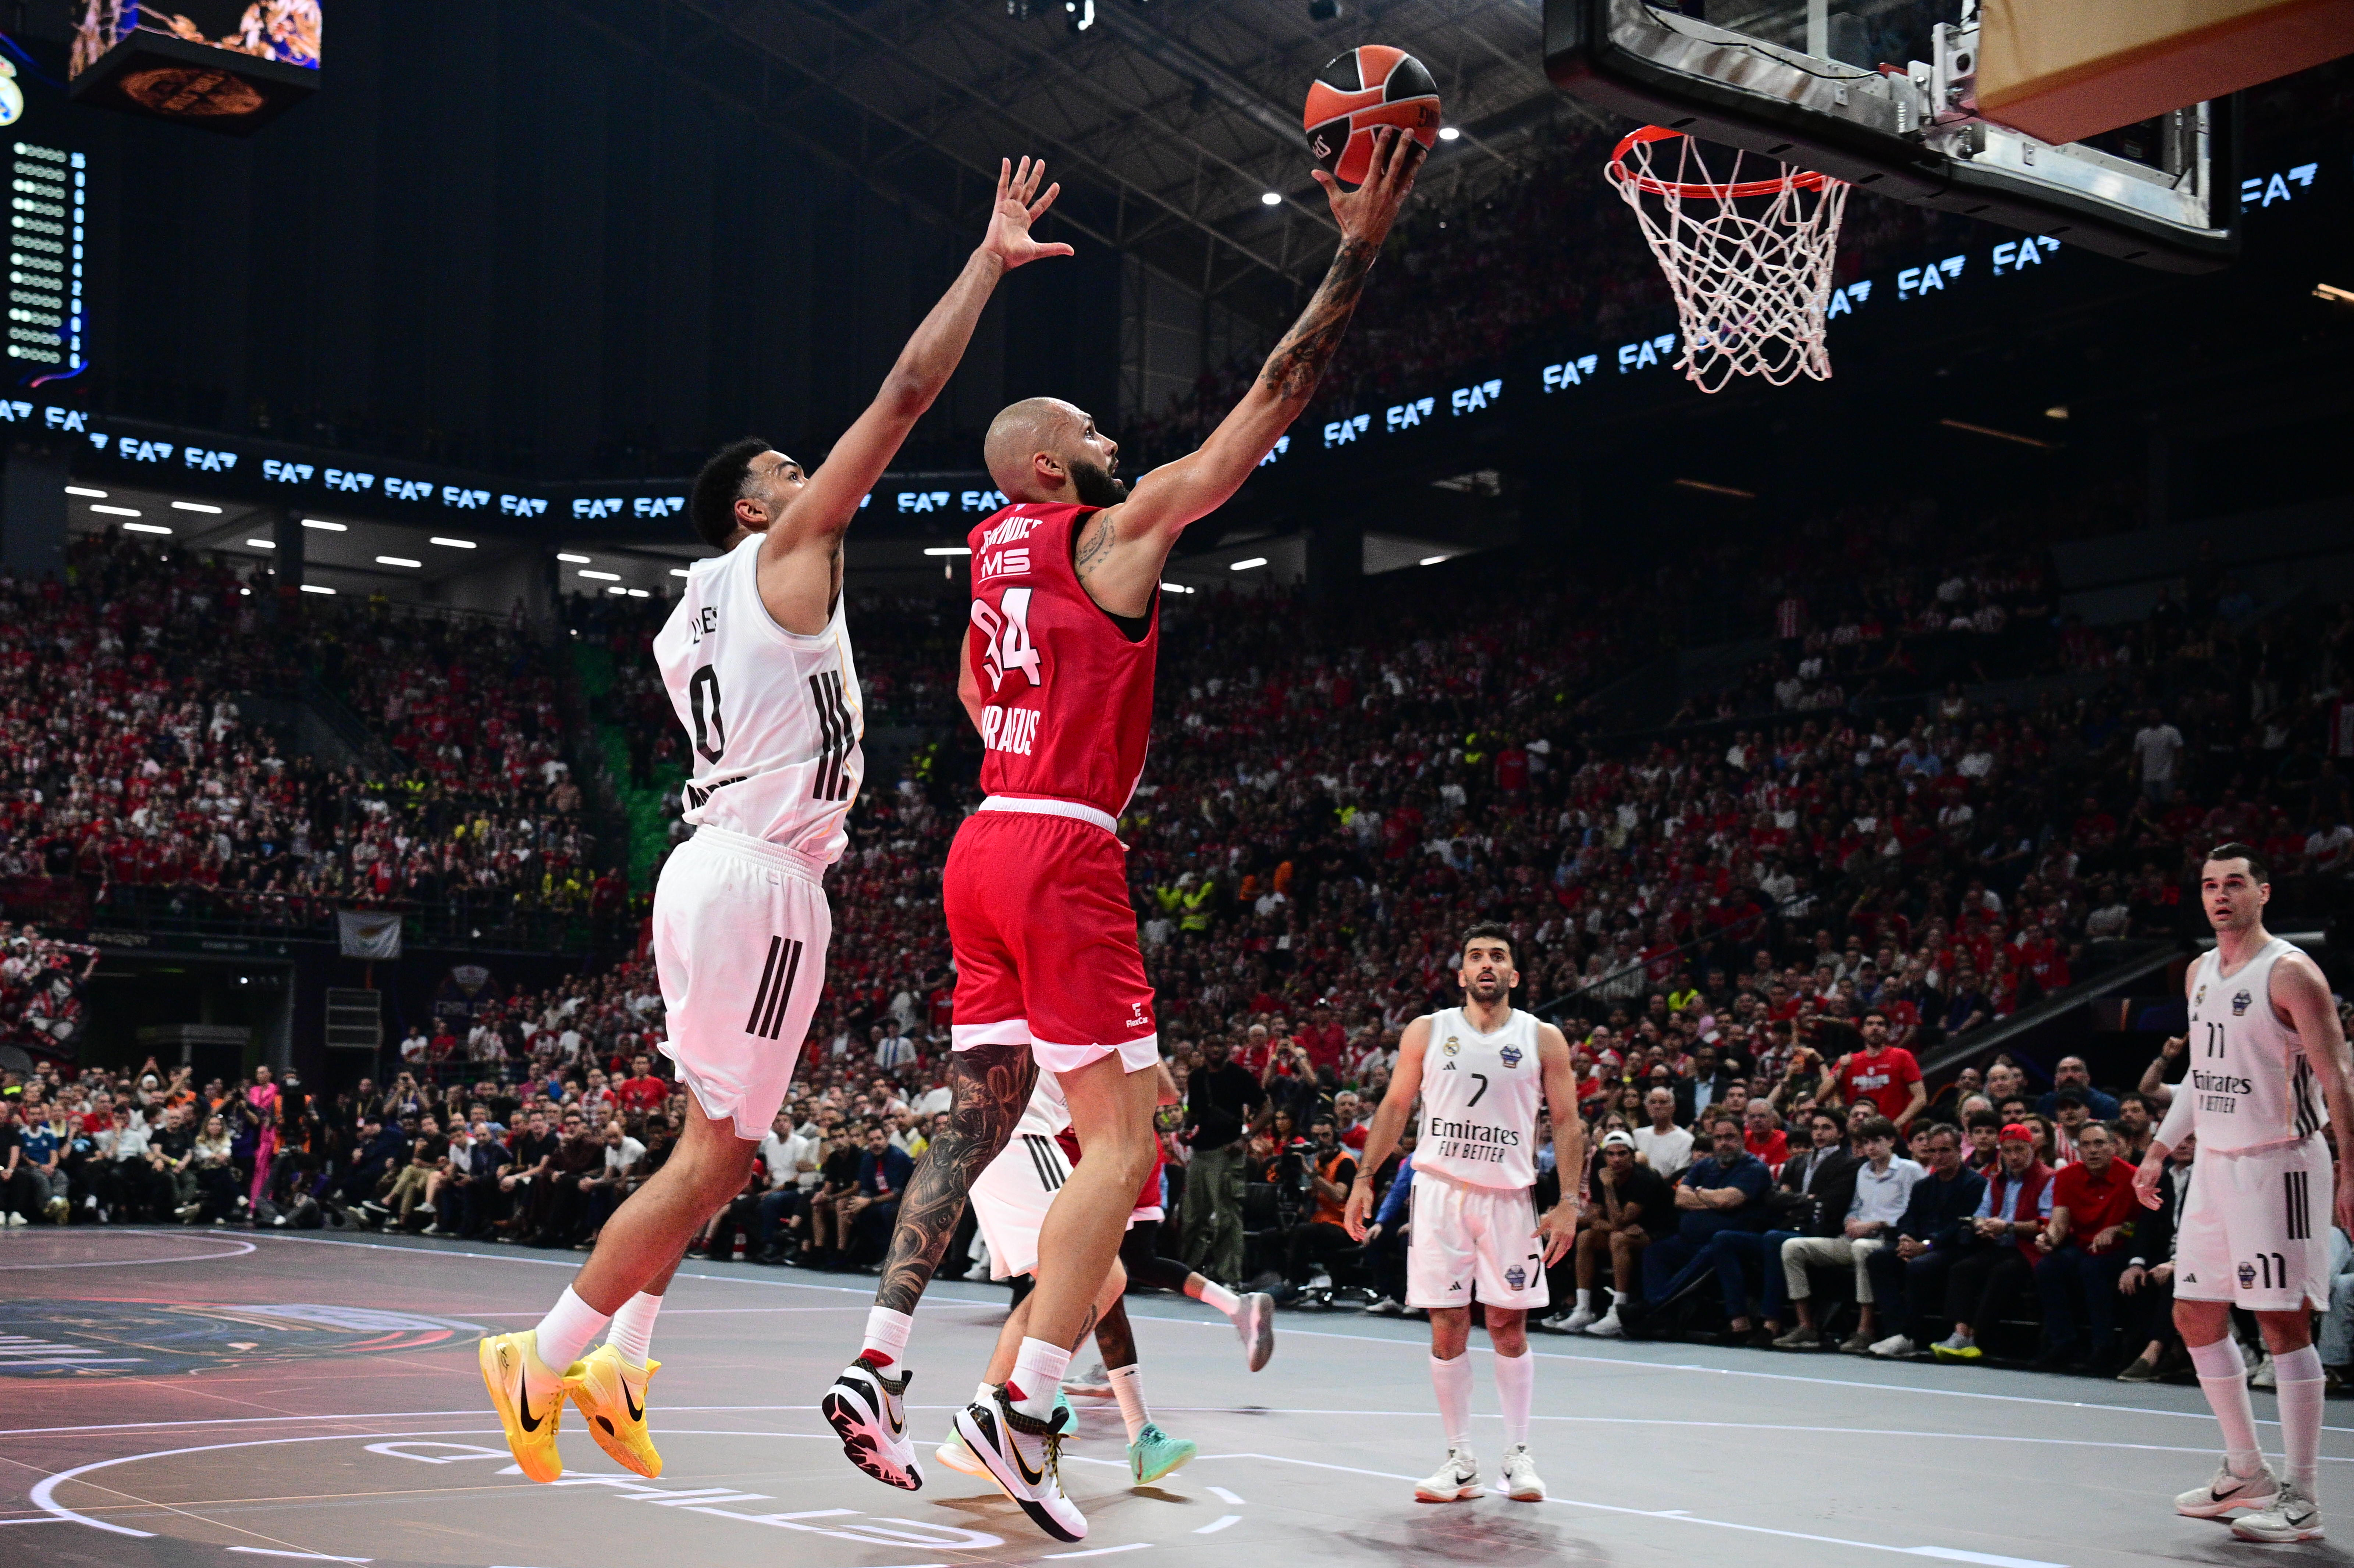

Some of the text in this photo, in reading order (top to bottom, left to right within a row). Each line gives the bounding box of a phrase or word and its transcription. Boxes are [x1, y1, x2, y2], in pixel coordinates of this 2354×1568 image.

[690, 663, 725, 765] 0
[1126, 1017, 1148, 1028] FlexCar
[2207, 1022, 2225, 1059] 11
[1466, 1073, 1488, 1107] 7
[1432, 1118, 1520, 1146] Emirates
[1438, 1141, 1505, 1163] FLY BETTER
[1528, 1254, 1540, 1288] 7
[2256, 1252, 2286, 1289] 11
